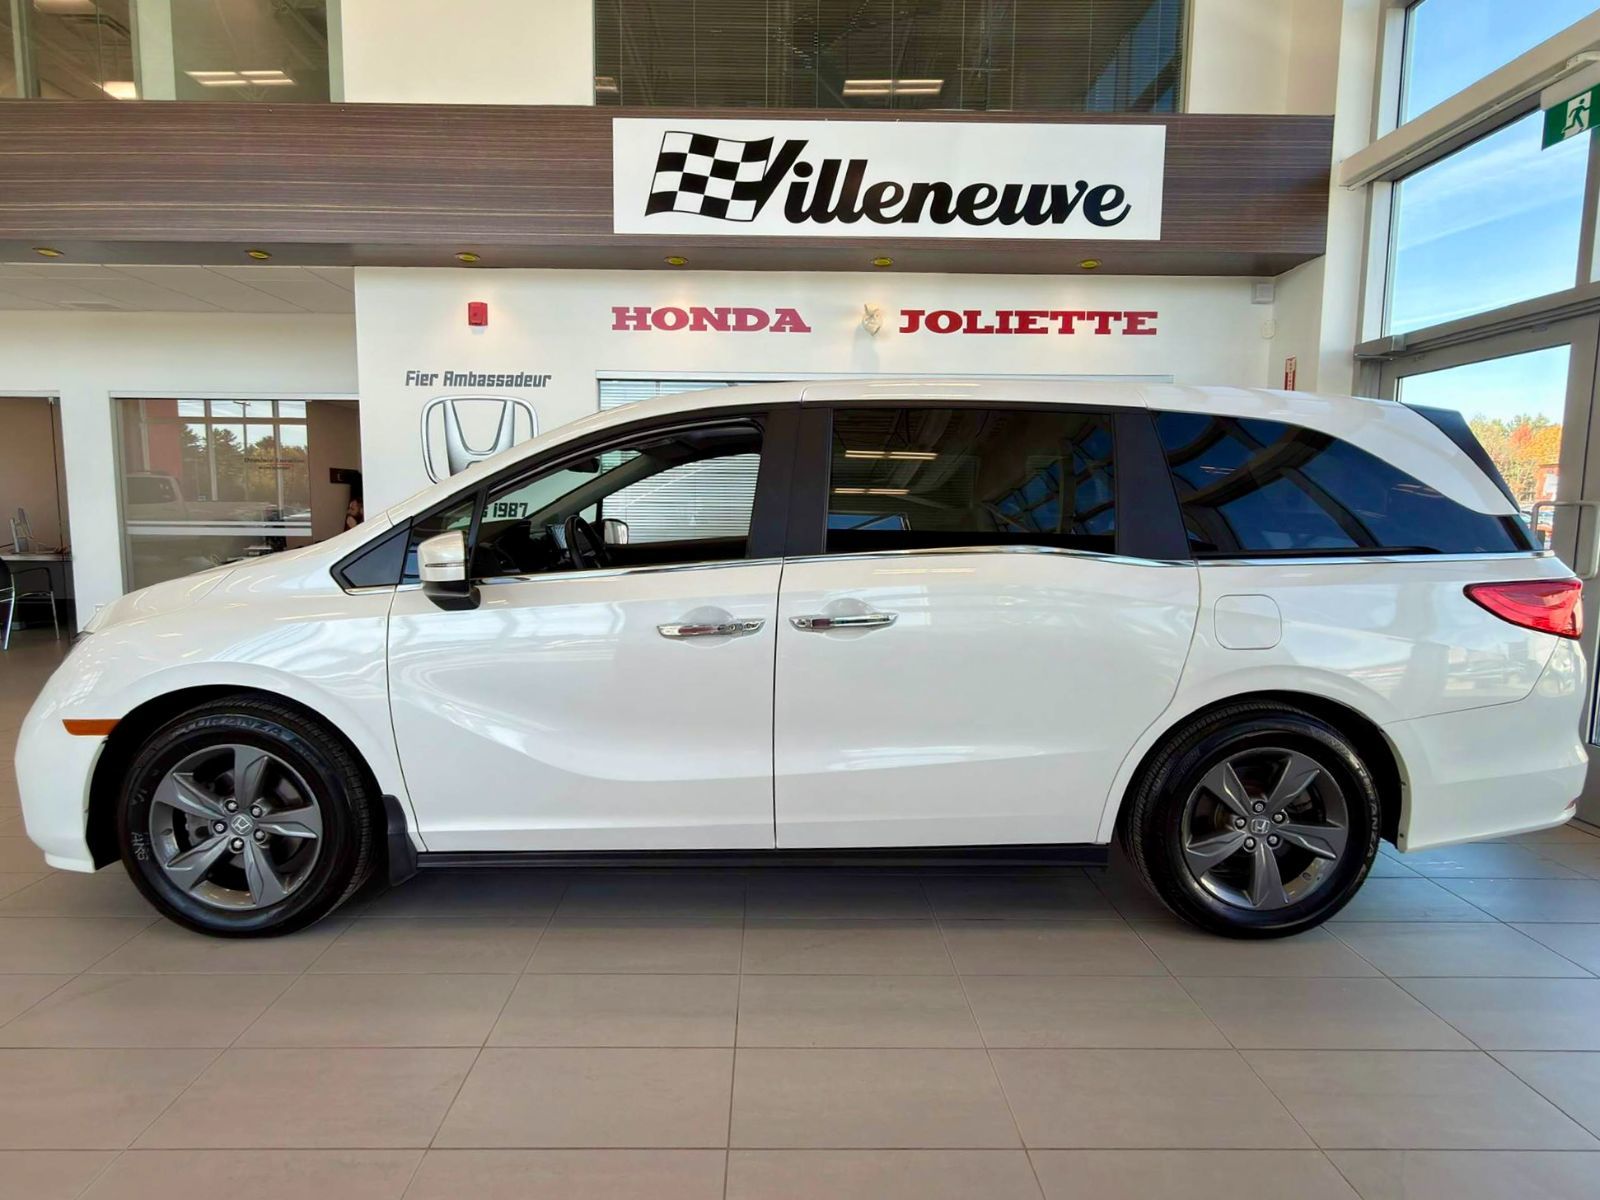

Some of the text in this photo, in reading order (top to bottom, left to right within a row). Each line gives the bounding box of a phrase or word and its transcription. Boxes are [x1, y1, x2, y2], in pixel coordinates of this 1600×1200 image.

[750, 138, 1132, 228] Villeneuve
[611, 306, 1158, 336] HONDA JOLIETTE
[405, 370, 552, 388] Fier Ambassadeur
